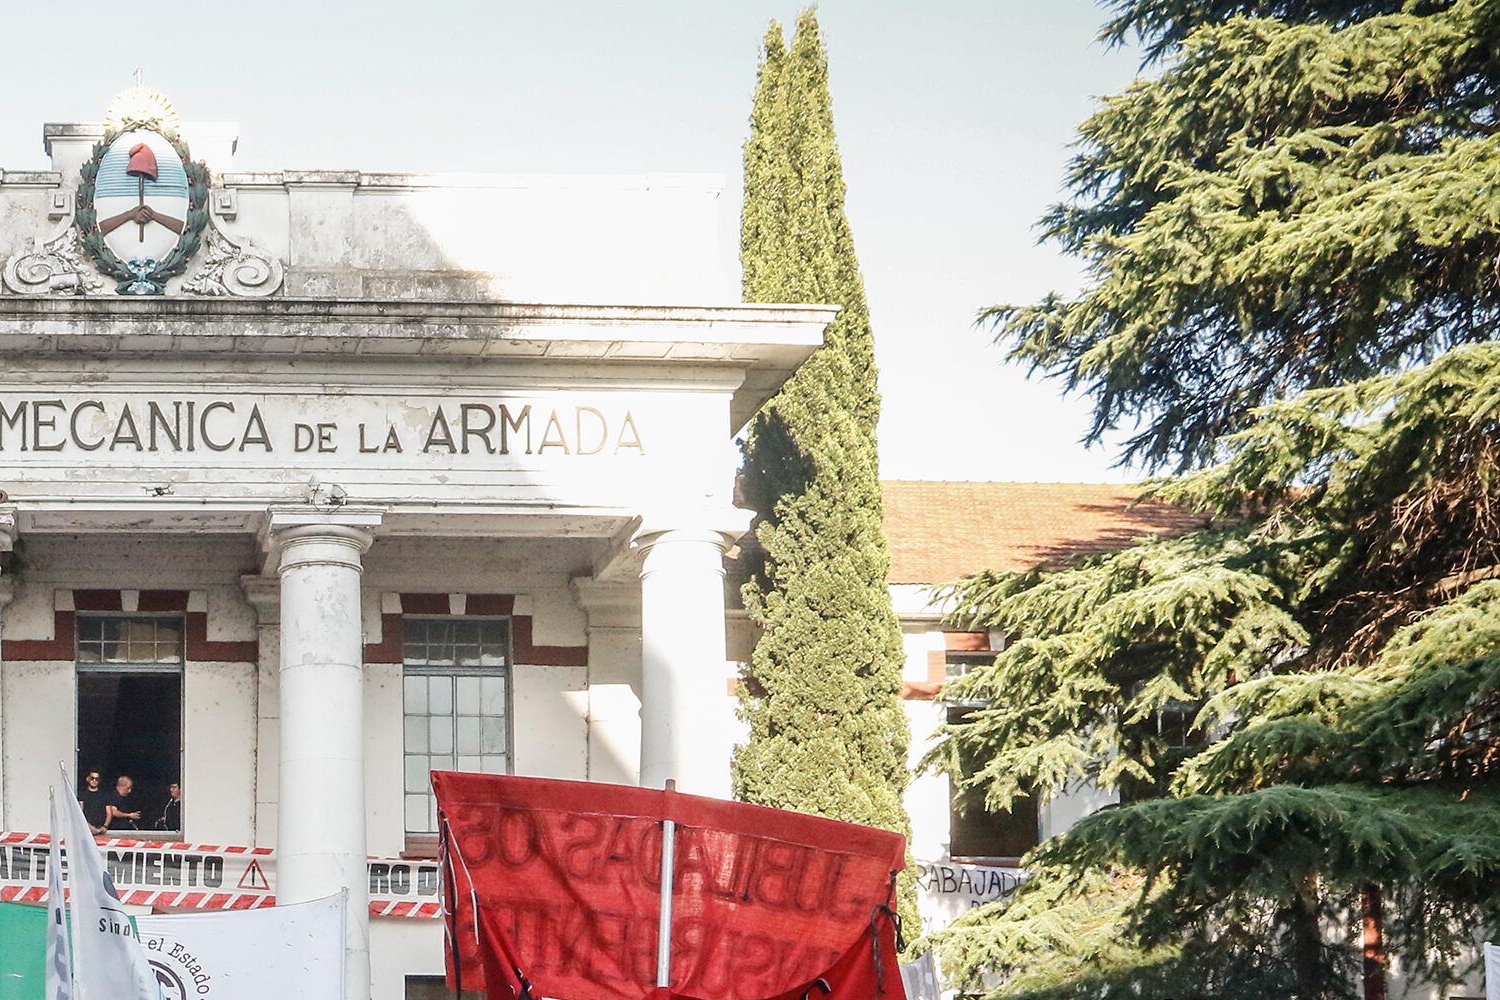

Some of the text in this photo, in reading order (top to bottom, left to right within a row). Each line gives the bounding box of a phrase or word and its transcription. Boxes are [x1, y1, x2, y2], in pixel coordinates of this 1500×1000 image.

[294, 423, 338, 453] DE
[359, 423, 403, 453] LA
[423, 402, 646, 456] ARMADA
[167, 942, 212, 994] Estado
